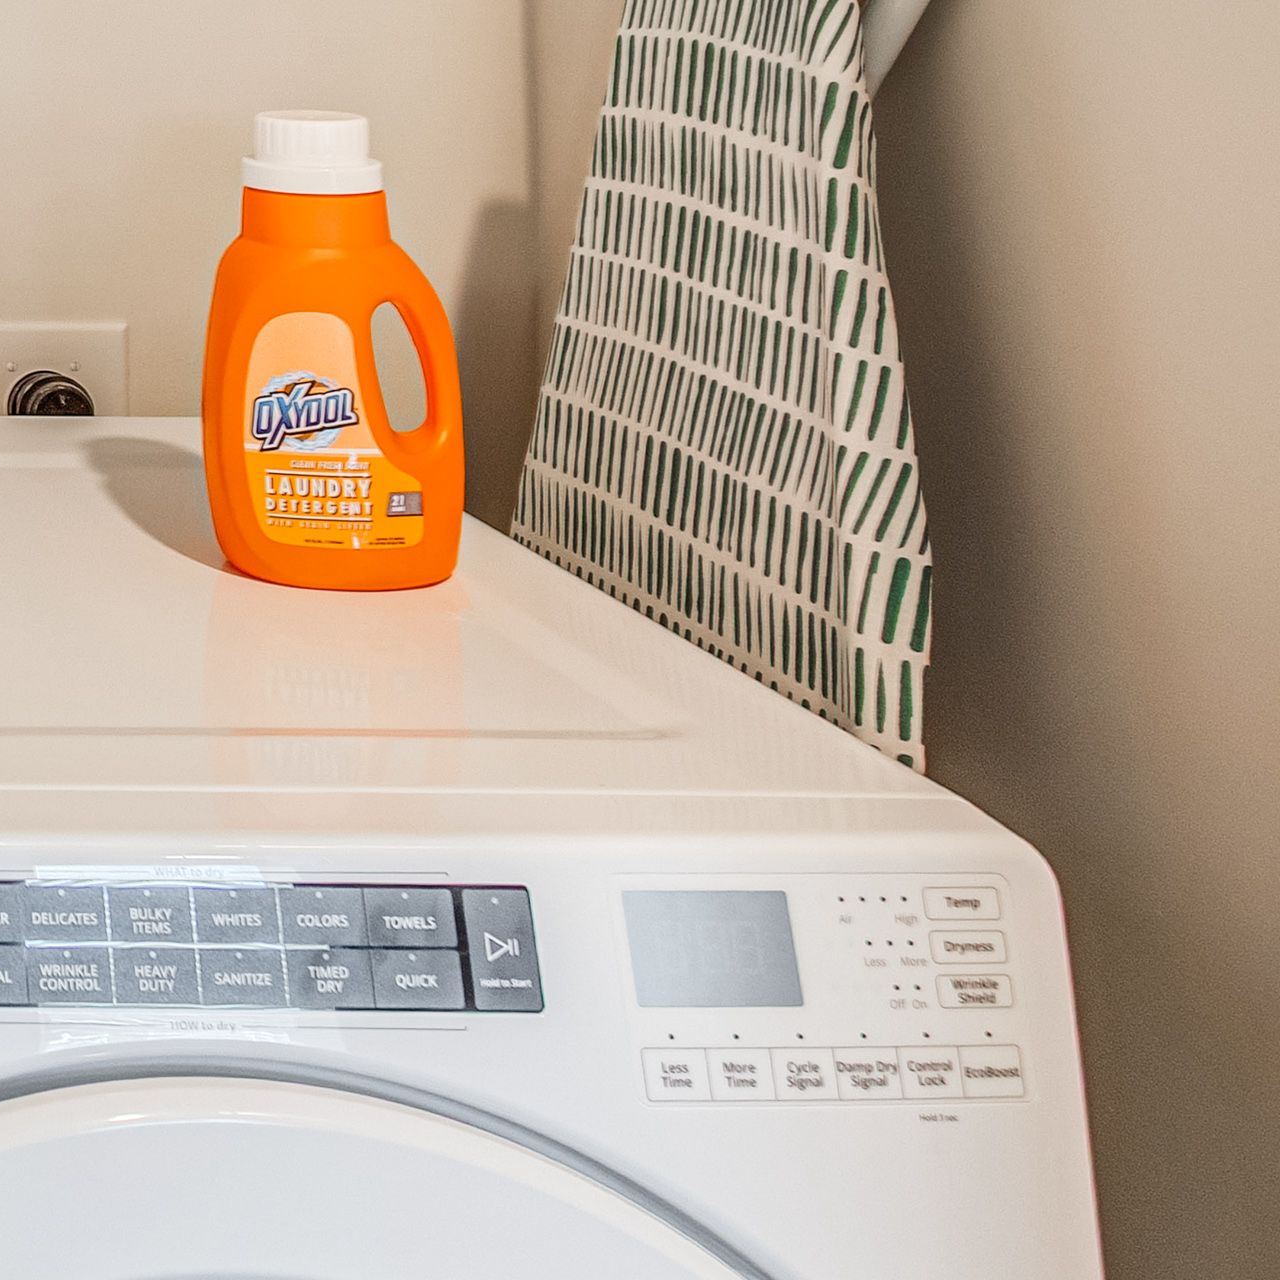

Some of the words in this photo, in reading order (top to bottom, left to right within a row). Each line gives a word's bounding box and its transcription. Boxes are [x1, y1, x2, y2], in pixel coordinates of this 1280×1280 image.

[252, 381, 359, 451] OXYDOL
[264, 475, 372, 498] LAUNDRY
[264, 497, 373, 516] DETERGENT
[943, 896, 982, 910] Temp
[31, 912, 98, 926] DELICATES
[129, 907, 172, 921] BULKY
[211, 913, 262, 928] WHITES
[296, 914, 350, 928] COLORS
[132, 921, 172, 935] ITEMS
[382, 916, 437, 930] TOWELS
[943, 940, 995, 955] Dryness
[863, 957, 887, 968] Less
[900, 957, 928, 968] More
[39, 964, 98, 978] WRINKLE
[134, 965, 178, 979] HEAVY
[307, 965, 350, 979] TIMED
[39, 977, 102, 992] CONTROL
[138, 978, 175, 992] DUTY
[214, 972, 273, 986] SANITIZE
[316, 979, 344, 993] DRY
[395, 973, 439, 989] QUICK
[950, 977, 1000, 991] Wrinkle
[890, 999, 906, 1010] Off
[912, 999, 928, 1010] On
[957, 991, 997, 1005] Shield
[661, 1061, 689, 1075] Less
[722, 1061, 756, 1075] More
[787, 1060, 820, 1076] Cycle
[835, 1060, 874, 1076] Damp
[876, 1060, 898, 1075] Dry
[906, 1059, 953, 1073] Control
[963, 1065, 1021, 1079] EcoBoost
[661, 1075, 693, 1089] Time
[725, 1075, 758, 1089] Time
[787, 1074, 825, 1090] Signal
[850, 1075, 889, 1090] Signal
[917, 1073, 947, 1087] Lock
